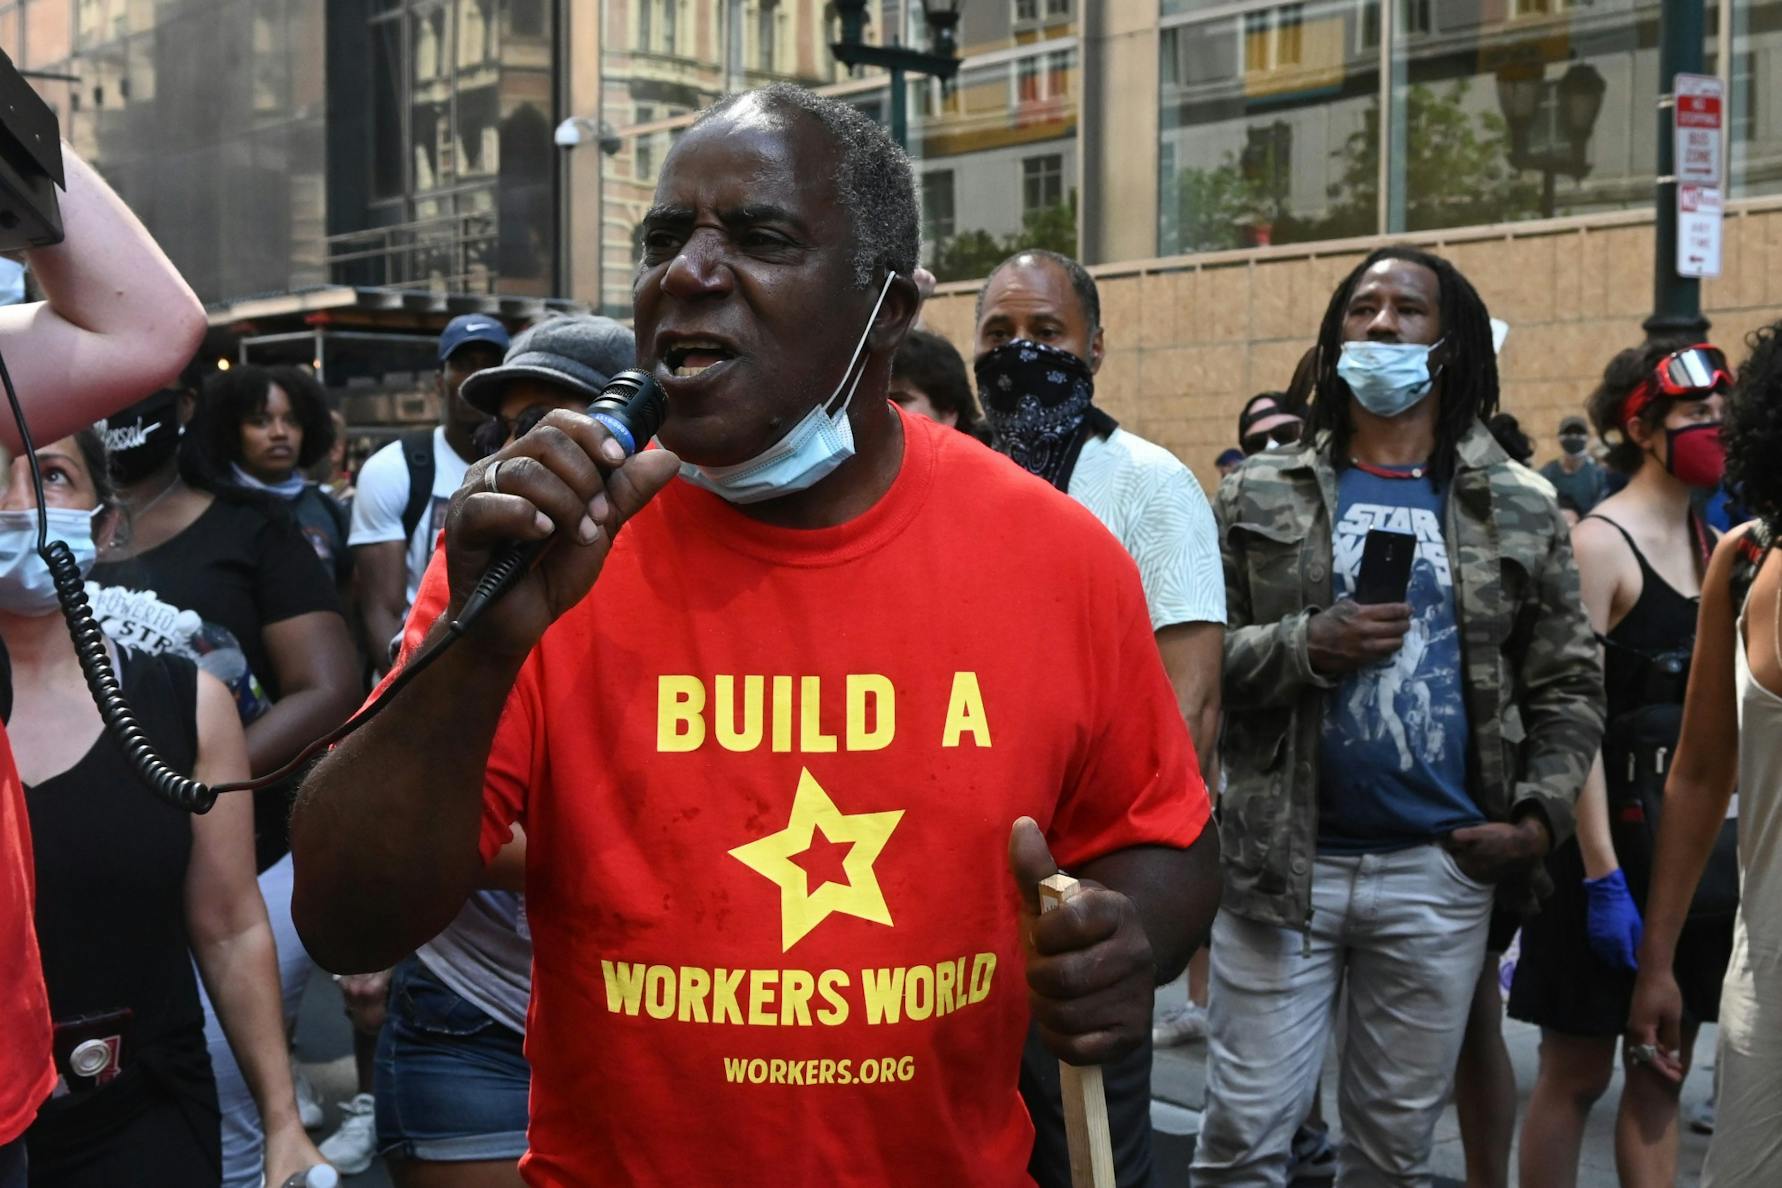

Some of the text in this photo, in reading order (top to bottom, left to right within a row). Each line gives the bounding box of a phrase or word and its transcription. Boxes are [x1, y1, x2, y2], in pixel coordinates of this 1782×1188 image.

[1338, 503, 1444, 542] STAR
[656, 671, 993, 753] BUILD A
[601, 952, 998, 1027] WORKERS WORLD
[723, 1055, 915, 1086] WORKERS.ORG
